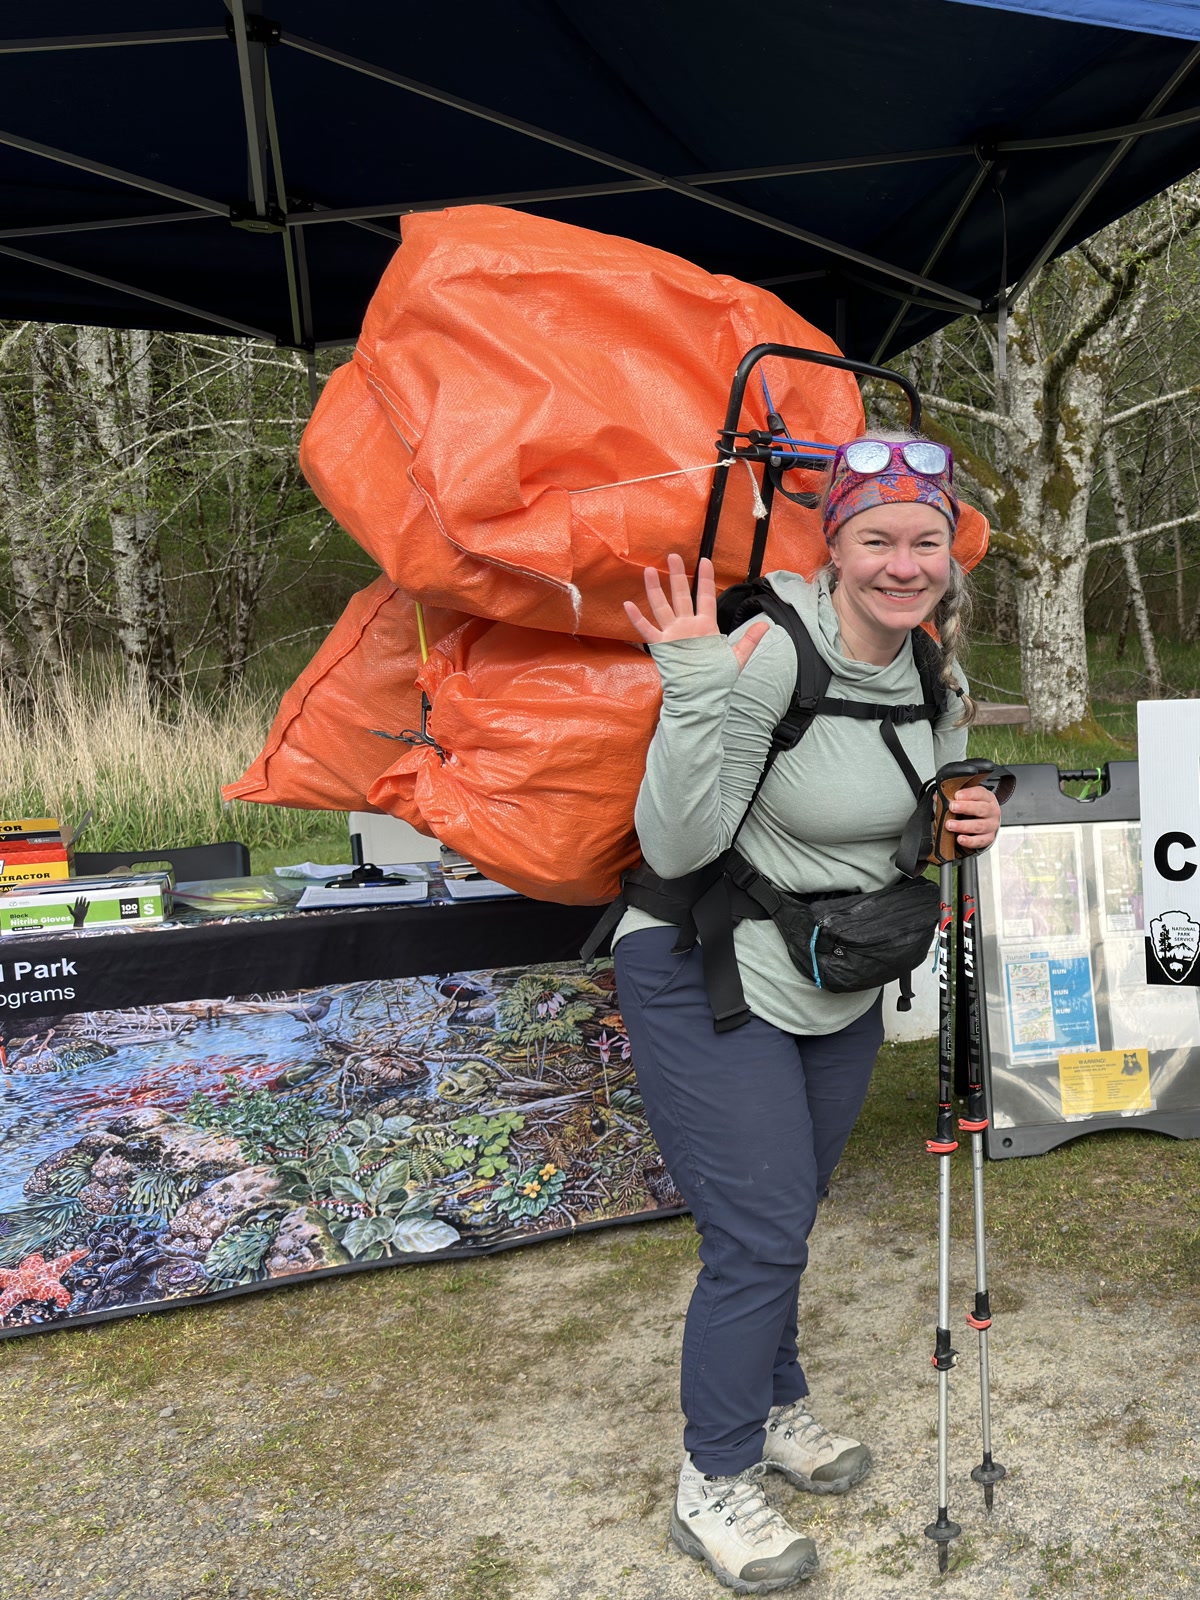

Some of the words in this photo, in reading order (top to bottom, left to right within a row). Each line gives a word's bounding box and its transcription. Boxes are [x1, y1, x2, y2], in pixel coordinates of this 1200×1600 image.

[121, 903, 138, 911] 100
[143, 903, 155, 915] S
[10, 917, 39, 926] Nitrile
[40, 915, 72, 924] Gloves
[963, 920, 974, 978] LEKI
[939, 930, 948, 990] LEKI
[14, 957, 78, 981] Park
[1053, 988, 1069, 996] RUN
[1055, 1007, 1071, 1015] RUN
